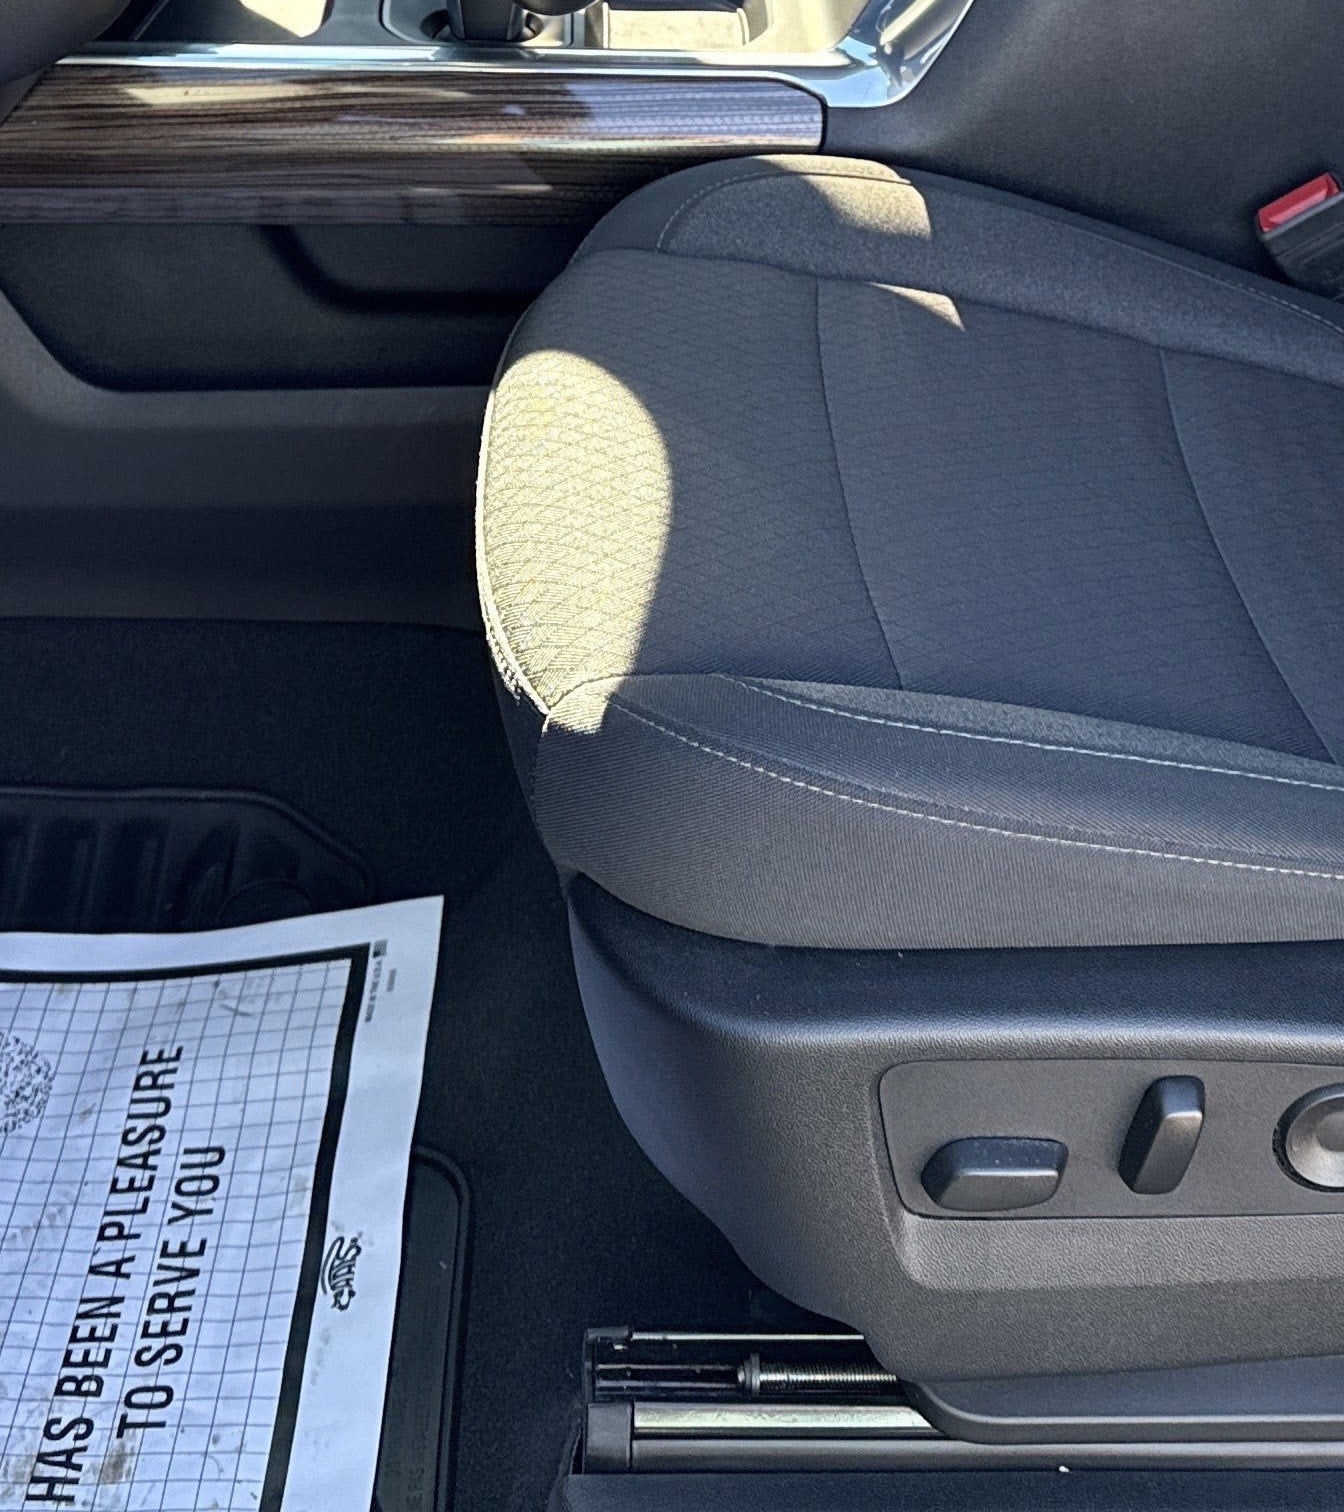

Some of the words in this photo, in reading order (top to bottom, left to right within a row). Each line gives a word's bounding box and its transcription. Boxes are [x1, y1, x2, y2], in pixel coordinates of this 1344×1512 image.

[96, 1045, 184, 1242] PLEASURE
[167, 1145, 227, 1225] YOU
[87, 1254, 136, 1280] A
[134, 1237, 207, 1367] SERVE
[54, 1295, 126, 1398] BEEN
[116, 1384, 175, 1438] TO
[25, 1415, 95, 1502] HAS
